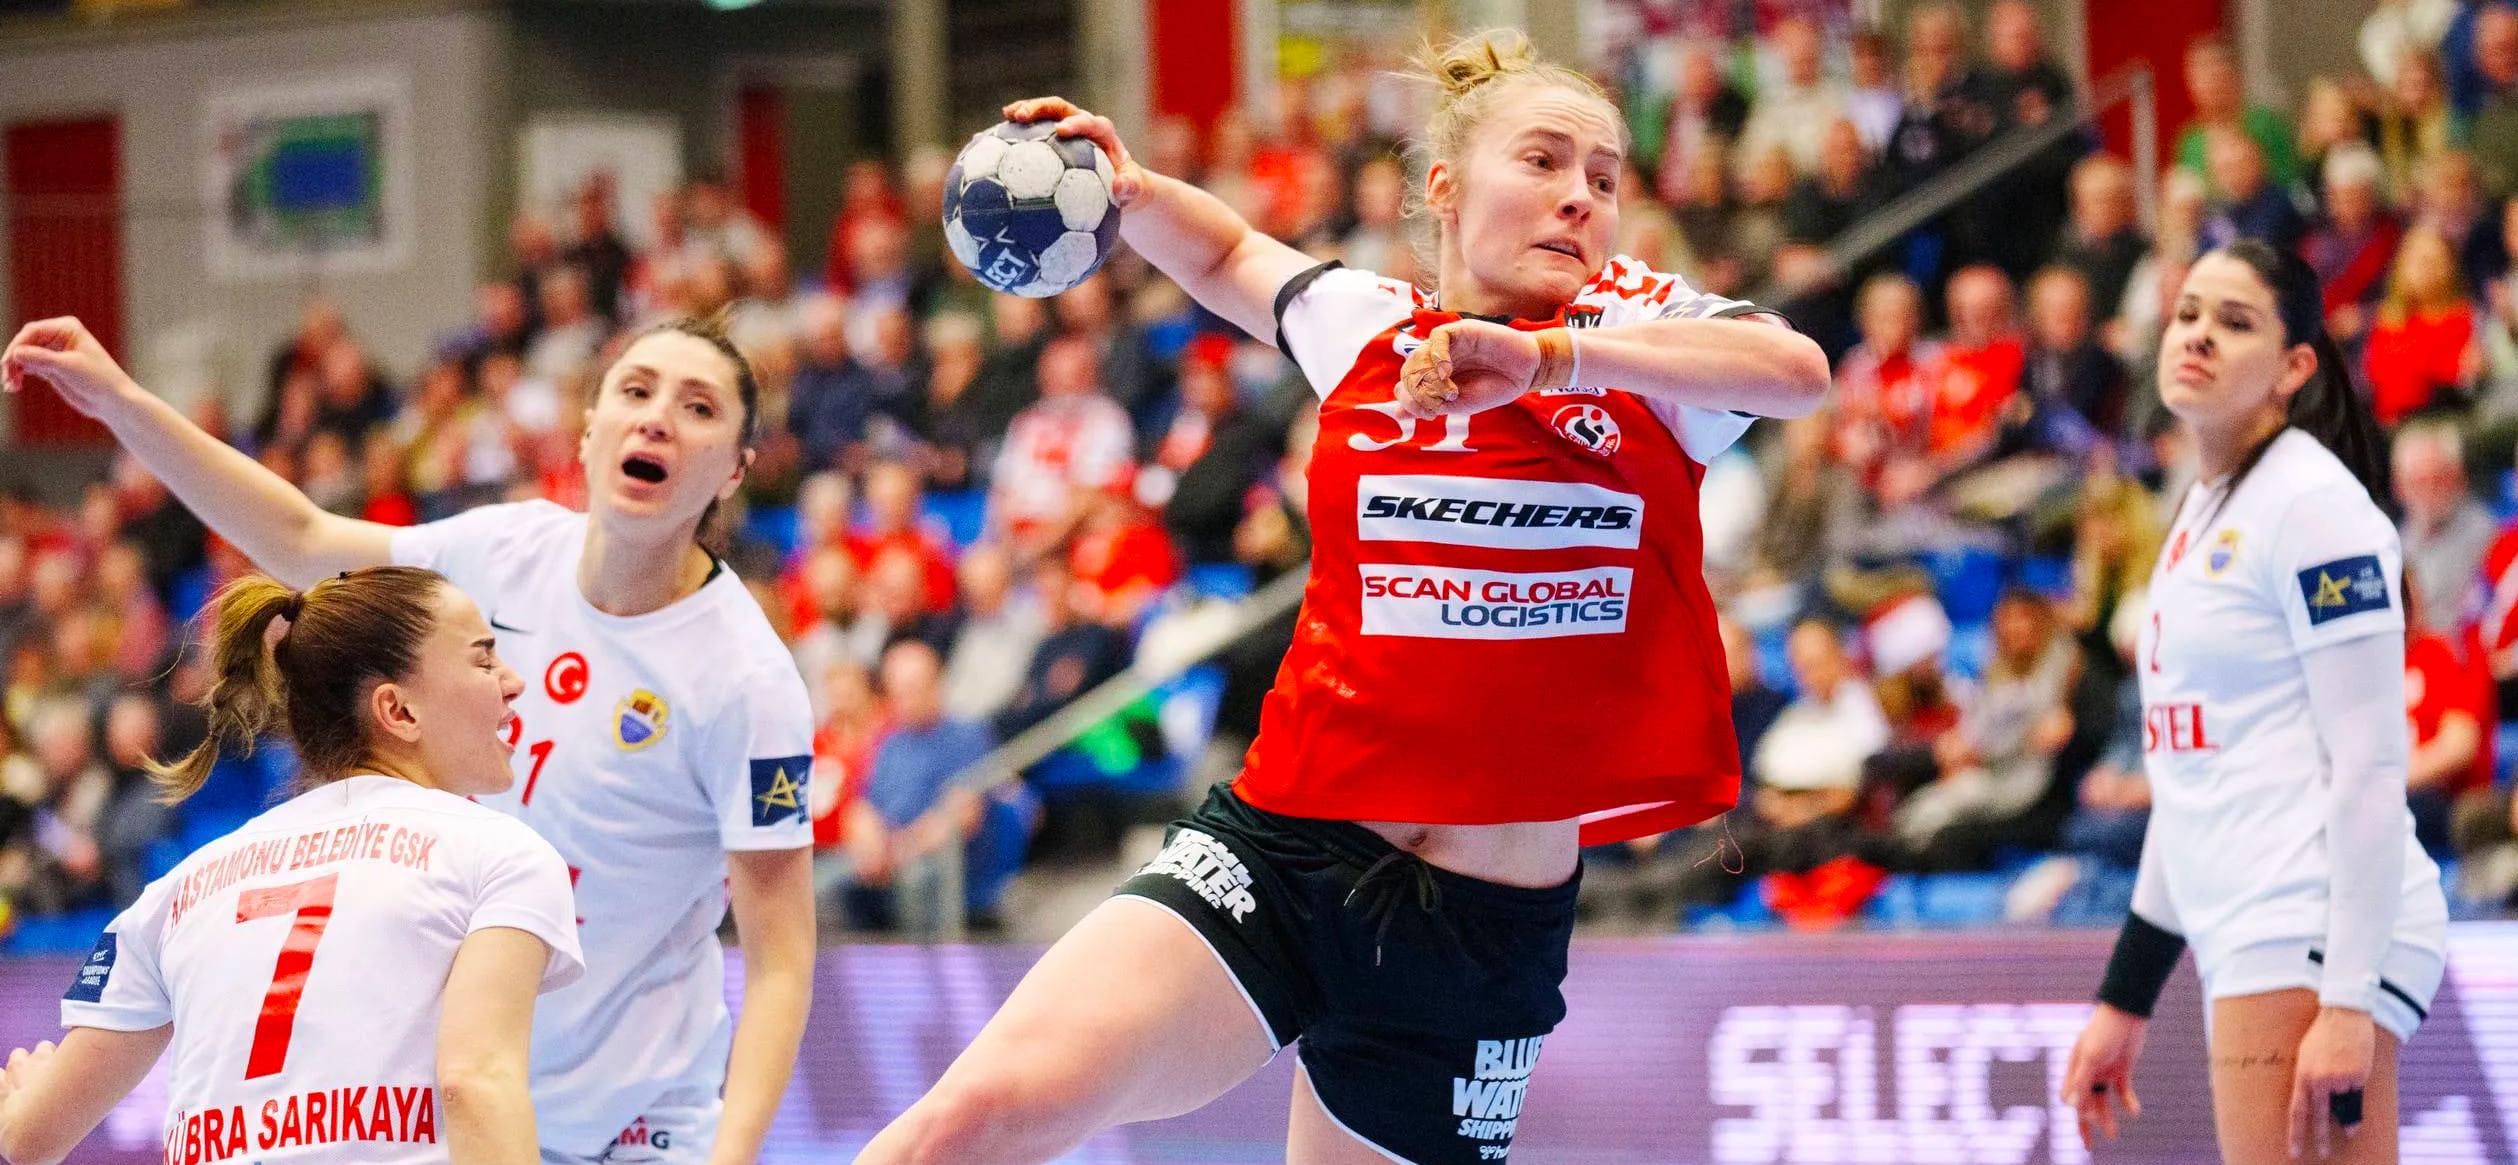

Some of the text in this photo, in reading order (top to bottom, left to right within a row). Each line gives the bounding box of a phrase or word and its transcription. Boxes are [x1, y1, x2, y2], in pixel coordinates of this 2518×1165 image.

[1365, 576, 1625, 603] SCAN GLOBAL
[1441, 600, 1624, 627] LOGISTICS
[2144, 703, 2220, 754] STEL
[390, 827, 437, 872] GSK
[236, 872, 339, 1080] 7
[258, 1086, 436, 1150] SARIKAYA
[1453, 1077, 1529, 1119] WAT
[1458, 1118, 1516, 1140] SHIPP
